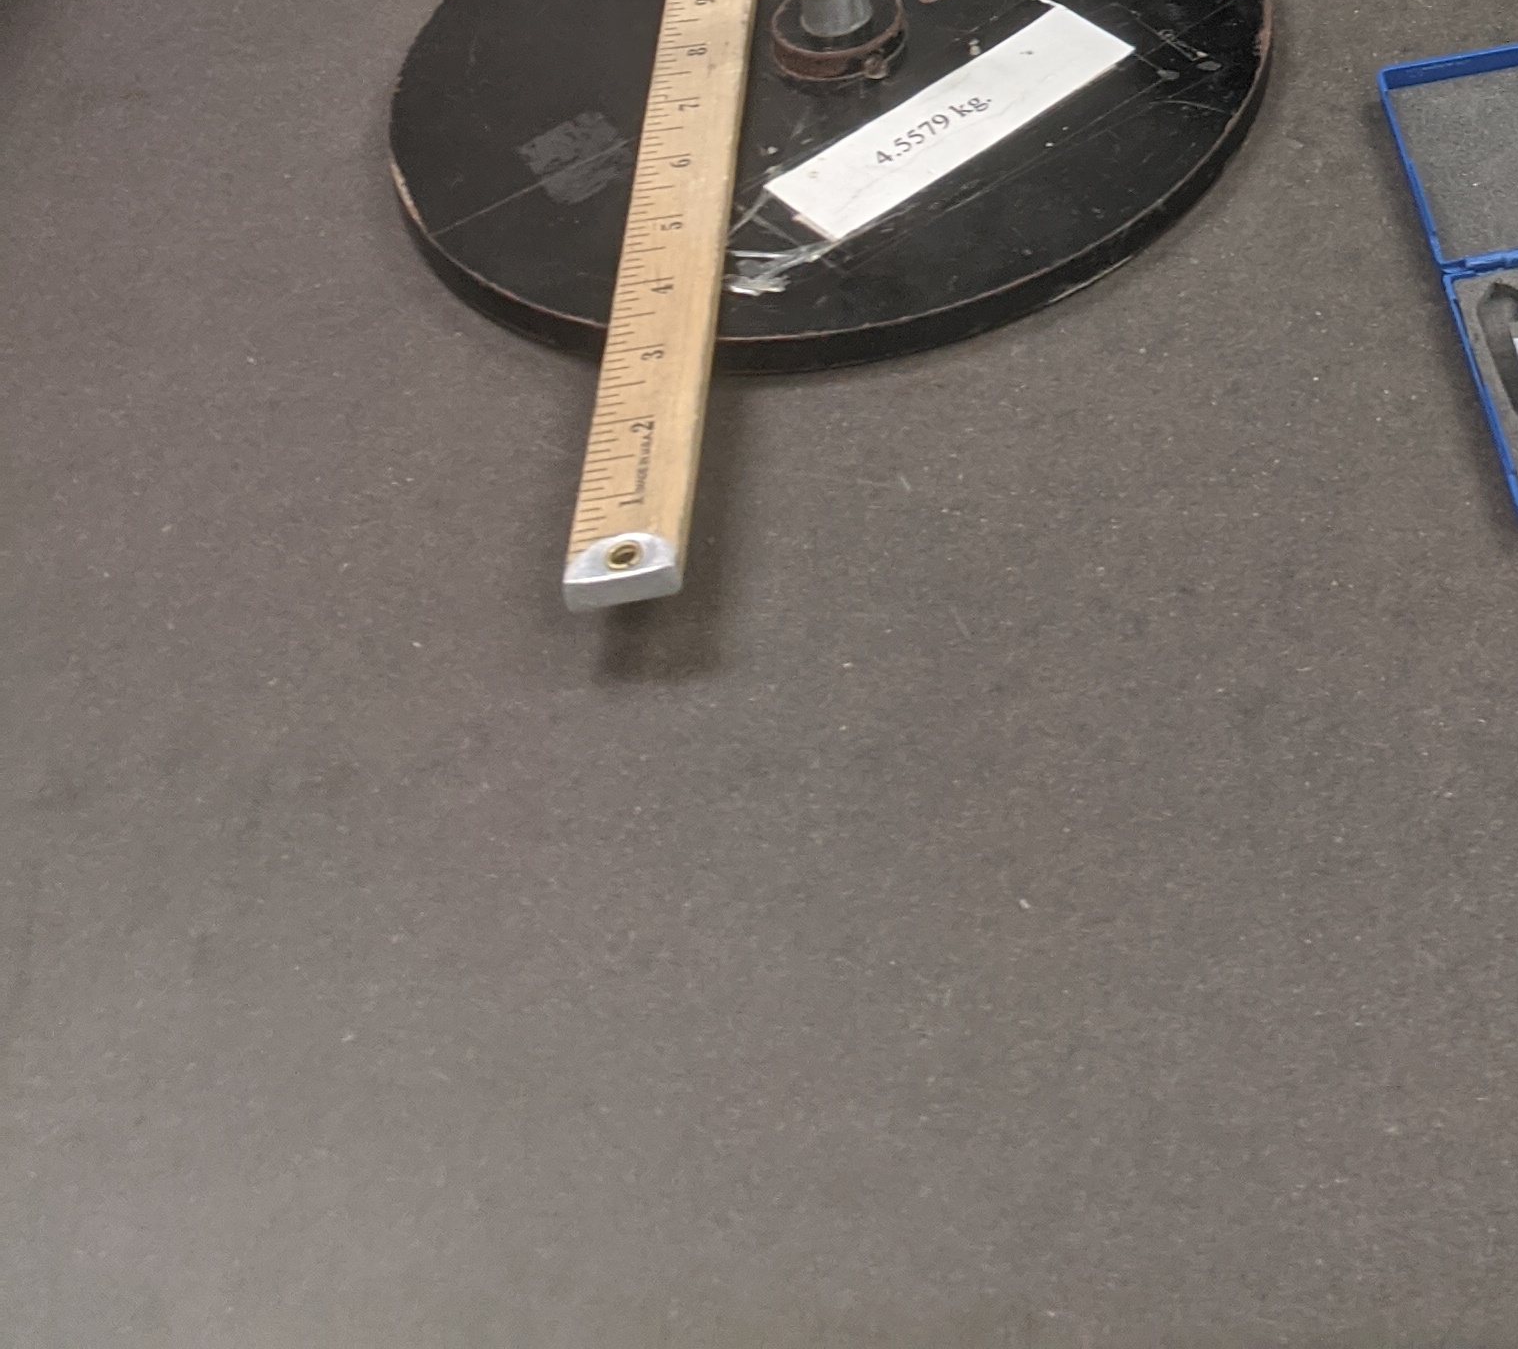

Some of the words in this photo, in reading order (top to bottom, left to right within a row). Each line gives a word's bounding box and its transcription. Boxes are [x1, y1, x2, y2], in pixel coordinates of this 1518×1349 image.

[687, 47, 707, 56] 8
[678, 103, 700, 112] 7
[876, 114, 950, 164] 4.5579
[948, 97, 992, 117] kg.
[669, 158, 691, 168] 6
[660, 221, 683, 231] 5
[651, 283, 674, 294] 4
[640, 350, 664, 361] 3
[631, 420, 655, 433] 2
[619, 498, 643, 507] 1
